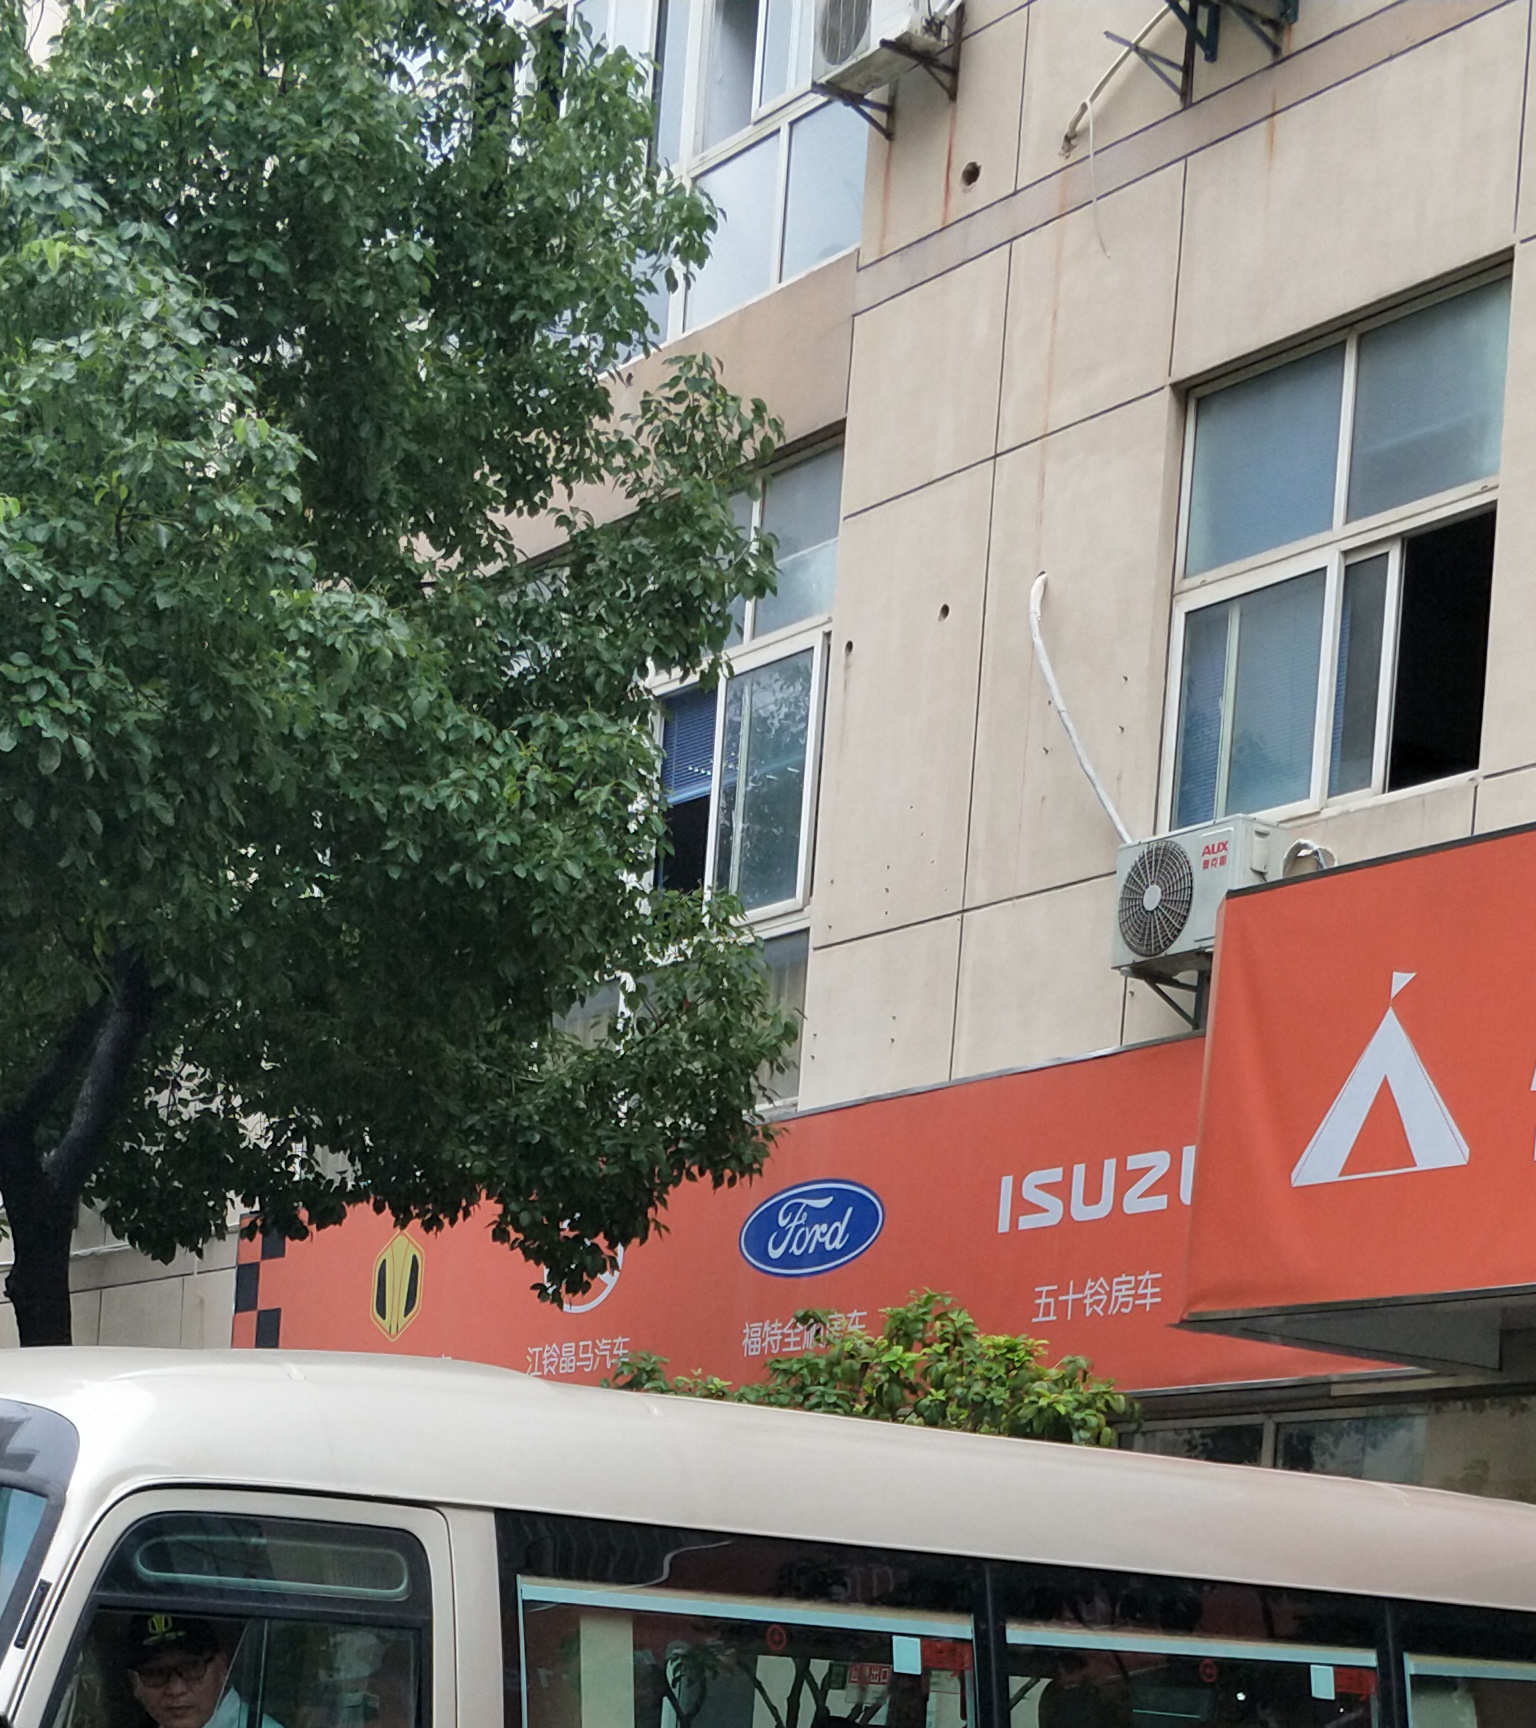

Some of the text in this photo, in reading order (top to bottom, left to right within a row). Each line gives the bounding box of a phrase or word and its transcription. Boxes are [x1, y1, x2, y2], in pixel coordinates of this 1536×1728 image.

[1201, 840, 1228, 858] AUX
[768, 1196, 854, 1260] Ford
[1031, 1270, 1163, 1323] 五十铃房车
[526, 1336, 632, 1377] 江铃晶马汽车
